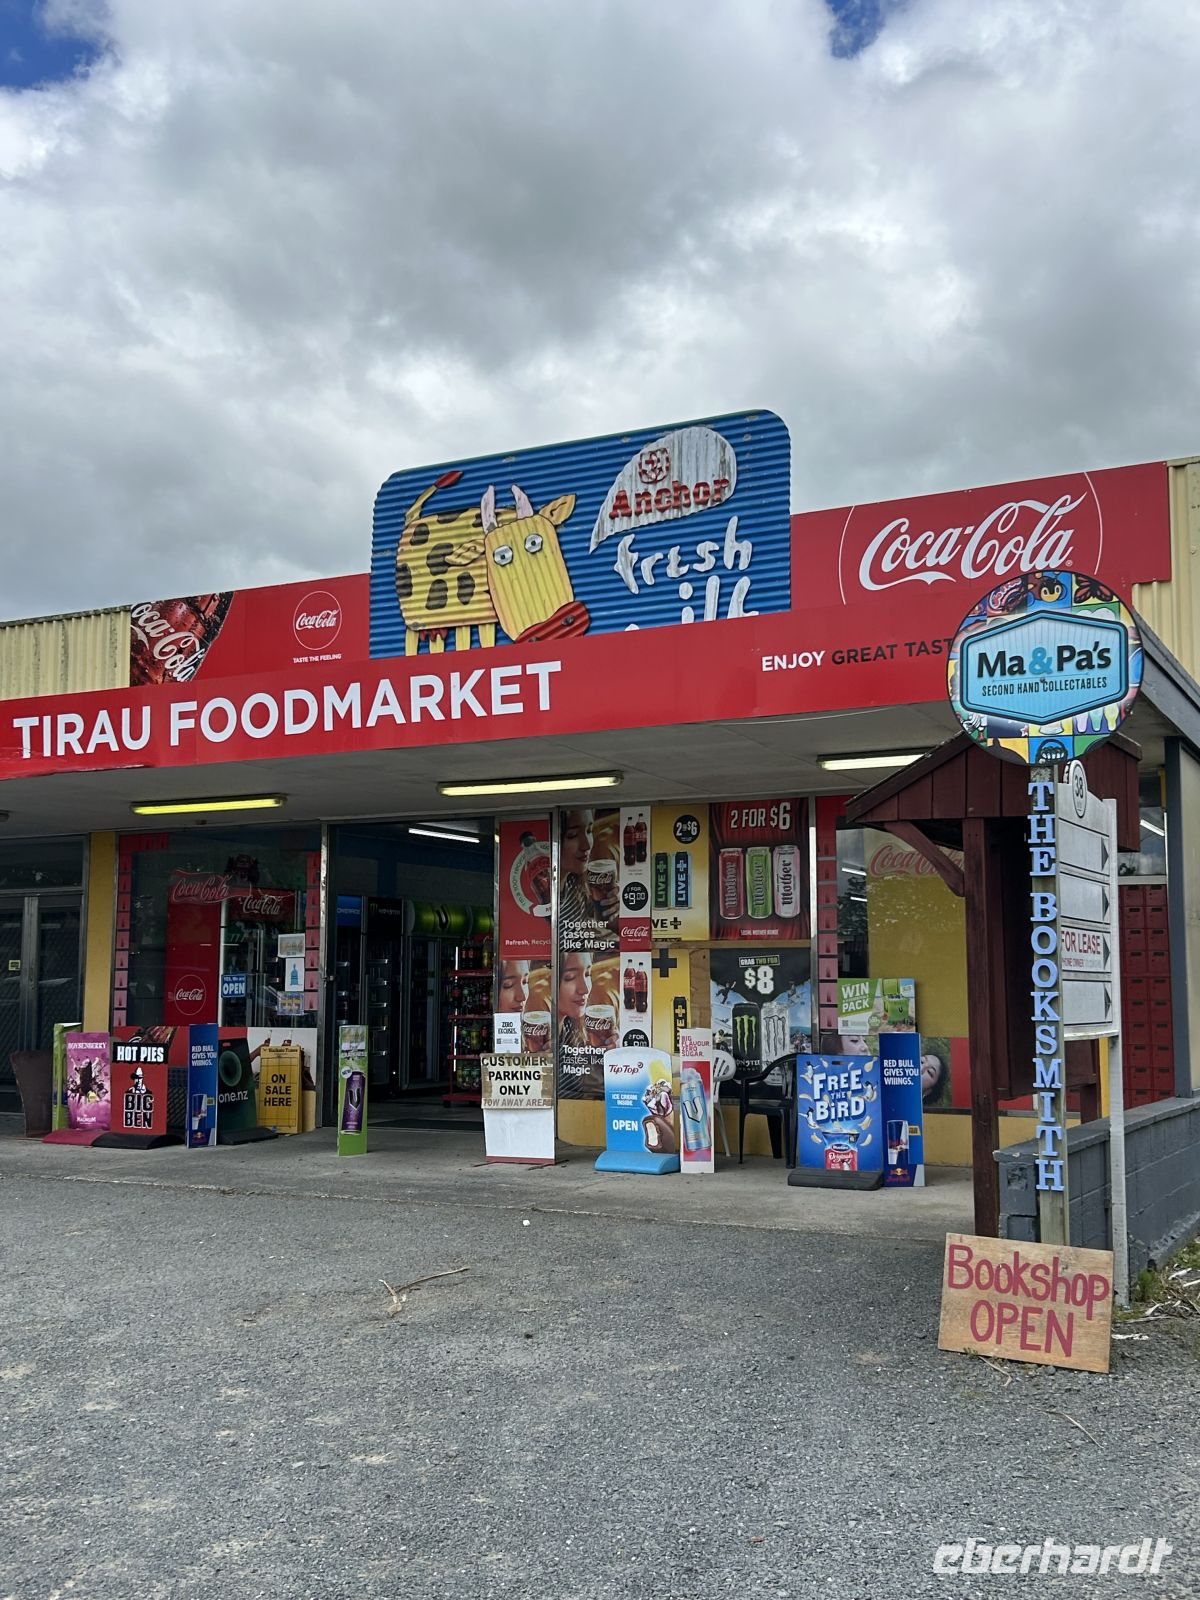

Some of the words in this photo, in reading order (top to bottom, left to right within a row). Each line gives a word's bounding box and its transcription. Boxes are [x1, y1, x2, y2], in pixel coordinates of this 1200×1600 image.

[609, 476, 730, 520] Anchor
[320, 653, 342, 661] FEELING
[761, 650, 825, 672] ENJOY
[831, 643, 895, 666] GREAT
[904, 636, 953, 658] TAST
[982, 682, 1015, 697] SECOND
[1017, 680, 1040, 694] HAND
[1043, 676, 1108, 692] COLLECTABLES
[170, 660, 562, 747] FOODMARKET
[13, 706, 151, 759] TIRAU
[731, 809, 739, 829] 2
[742, 808, 766, 828] FOR
[770, 801, 791, 830] $6
[1028, 781, 1056, 877] THE
[563, 920, 609, 931] Together
[563, 930, 596, 939] tastes
[563, 939, 582, 949] like
[584, 939, 615, 951] Magic
[1078, 933, 1101, 955] LEASE
[744, 965, 774, 994] $8
[223, 982, 246, 995] OPEN
[842, 981, 870, 999] WIN
[842, 998, 870, 1013] PACK
[1030, 892, 1065, 1192] BOOKSMITH
[116, 1046, 137, 1062] HOT
[140, 1046, 165, 1062] PIES
[562, 1044, 606, 1056] Together
[481, 1056, 548, 1067] CUSTOMER
[562, 1055, 589, 1065] tastes
[884, 1059, 897, 1068] RED
[898, 1059, 914, 1068] BULL
[488, 1070, 541, 1081] PARKING
[562, 1065, 591, 1077] Magic
[884, 1068, 904, 1076] GIVES
[904, 1068, 919, 1077] YOU
[271, 1073, 286, 1083] ON
[813, 1068, 863, 1100] FREE
[218, 1090, 249, 1103] one.nz
[265, 1085, 292, 1095] SALE
[499, 1085, 531, 1096] ONLY
[831, 1092, 847, 1100] THE
[123, 1093, 155, 1112] BIG
[264, 1097, 292, 1107] HERE
[483, 1098, 500, 1107] TOW
[501, 1098, 524, 1107] AWAY
[526, 1098, 548, 1107] AREA
[123, 1111, 153, 1129] BEN
[612, 1119, 639, 1131] OPEN
[948, 1243, 1110, 1321] Bookshop
[970, 1299, 1074, 1358] OPEN
